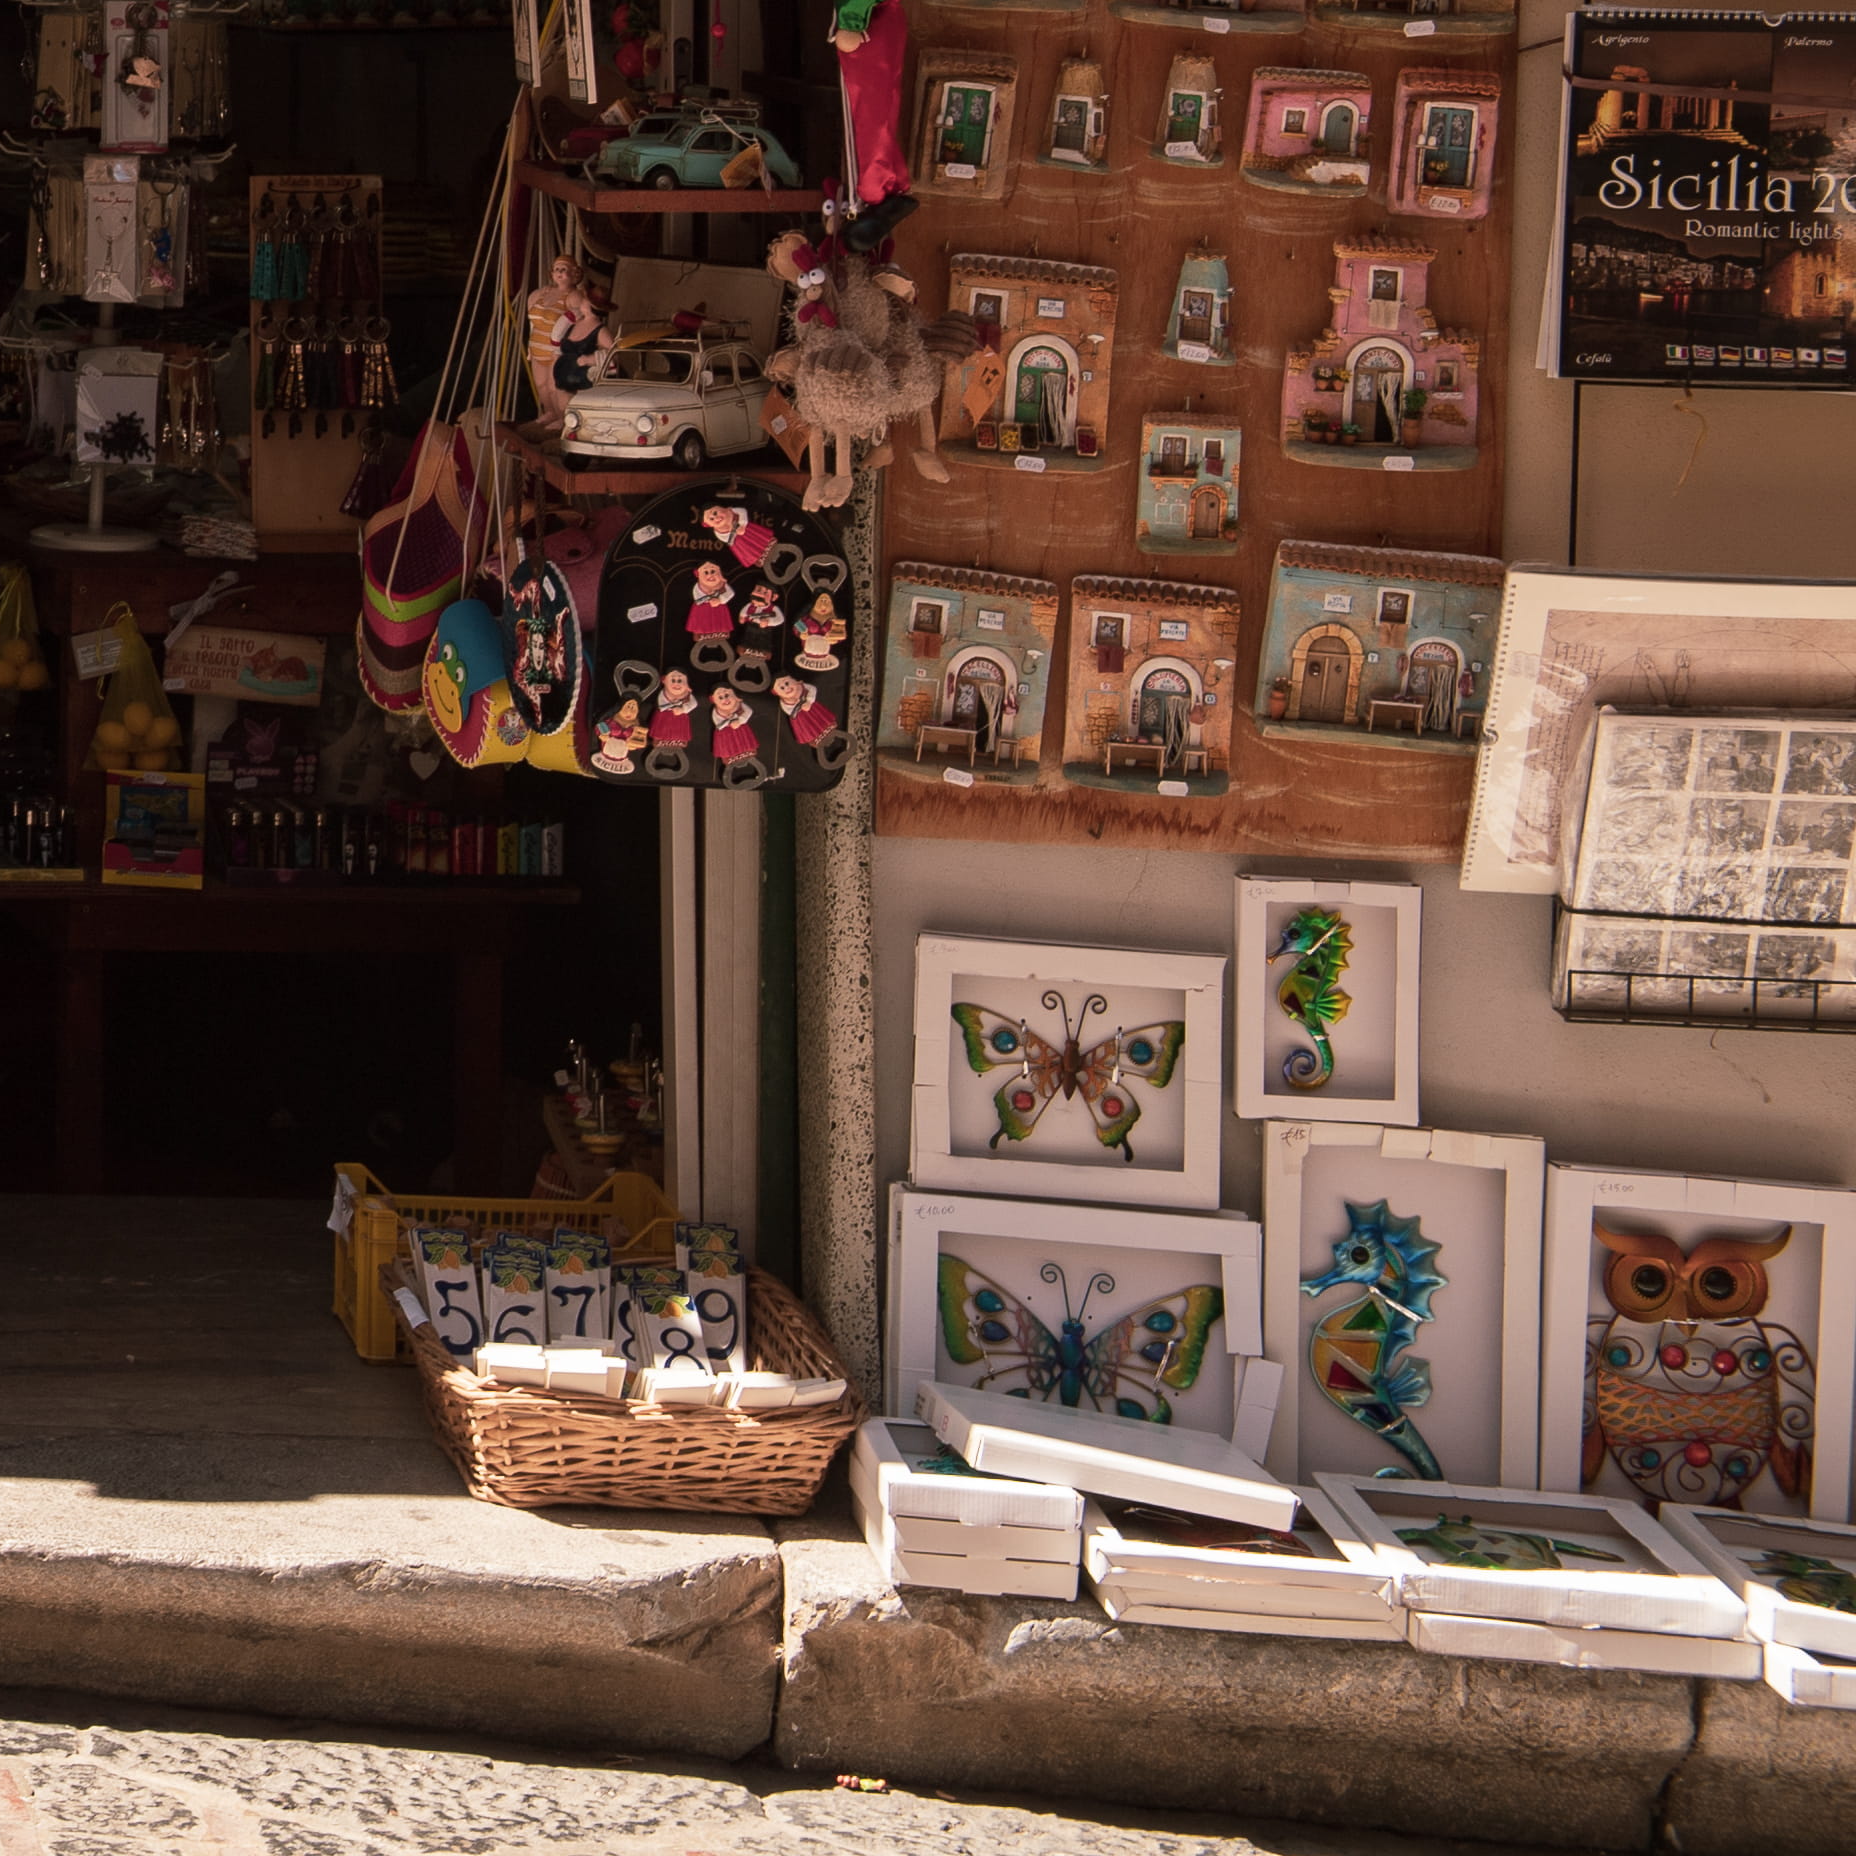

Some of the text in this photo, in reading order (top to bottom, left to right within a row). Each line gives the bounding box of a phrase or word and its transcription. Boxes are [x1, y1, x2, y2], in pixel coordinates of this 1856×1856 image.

[1592, 33, 1833, 49] Agrigento Palermo
[1598, 152, 1796, 214] Sicilia
[1684, 217, 1844, 246] Romantic lights
[1575, 351, 1612, 367] Cefalù
[433, 1279, 482, 1355] 5
[551, 1284, 596, 1337] 7
[697, 1287, 740, 1361] 9
